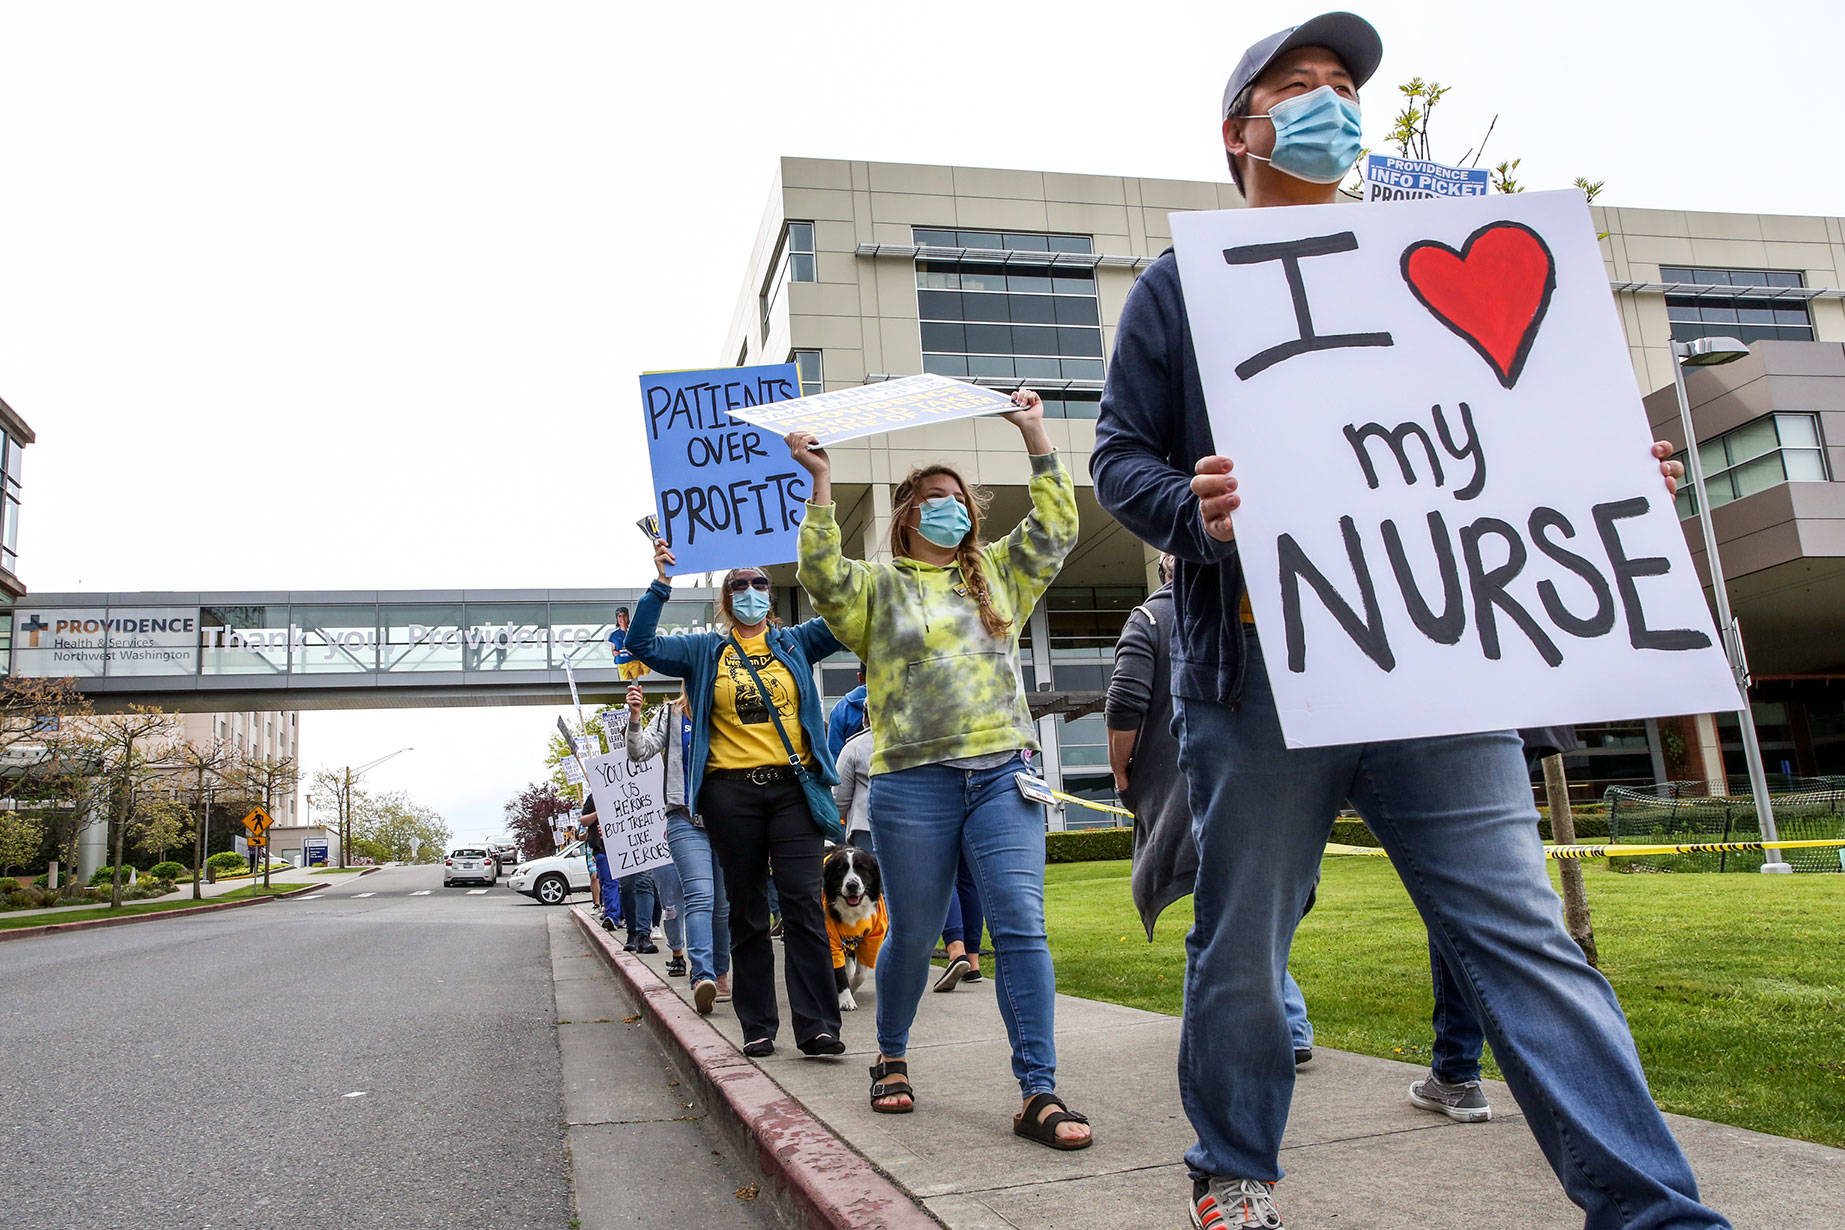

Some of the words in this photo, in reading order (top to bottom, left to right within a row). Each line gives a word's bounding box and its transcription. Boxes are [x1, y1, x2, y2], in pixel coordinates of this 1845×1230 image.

[1370, 168, 1414, 188] INFO
[1419, 175, 1484, 196] PICKET
[1386, 158, 1470, 180] PROVIDENCE
[1222, 231, 1394, 381] I
[647, 376, 795, 440] PATIENTS
[775, 386, 970, 426] PROVIDENCE
[796, 406, 913, 431] SHOULD
[909, 391, 984, 410] TAKE
[808, 418, 885, 437] CARE
[885, 411, 921, 423] OF
[924, 396, 1000, 415] THEM
[687, 432, 770, 467] OVER
[1342, 402, 1486, 500] my
[661, 472, 806, 548] PROFITS
[1277, 496, 1712, 673] NURSE
[56, 618, 194, 634] PROVIDENCE
[201, 624, 309, 654] Thank
[408, 621, 591, 651] Providence
[53, 651, 116, 662] Northwest
[120, 650, 190, 662] Washington
[54, 638, 92, 649] Health
[97, 638, 106, 649] &
[109, 637, 154, 649] Services
[594, 762, 624, 787] YOU
[621, 781, 640, 799] US
[604, 819, 625, 839] BUT
[627, 810, 654, 831] TREAT
[656, 806, 668, 821] U
[613, 794, 653, 818] HEROES
[627, 829, 653, 847] LIKE
[618, 842, 671, 870] ZEROES
